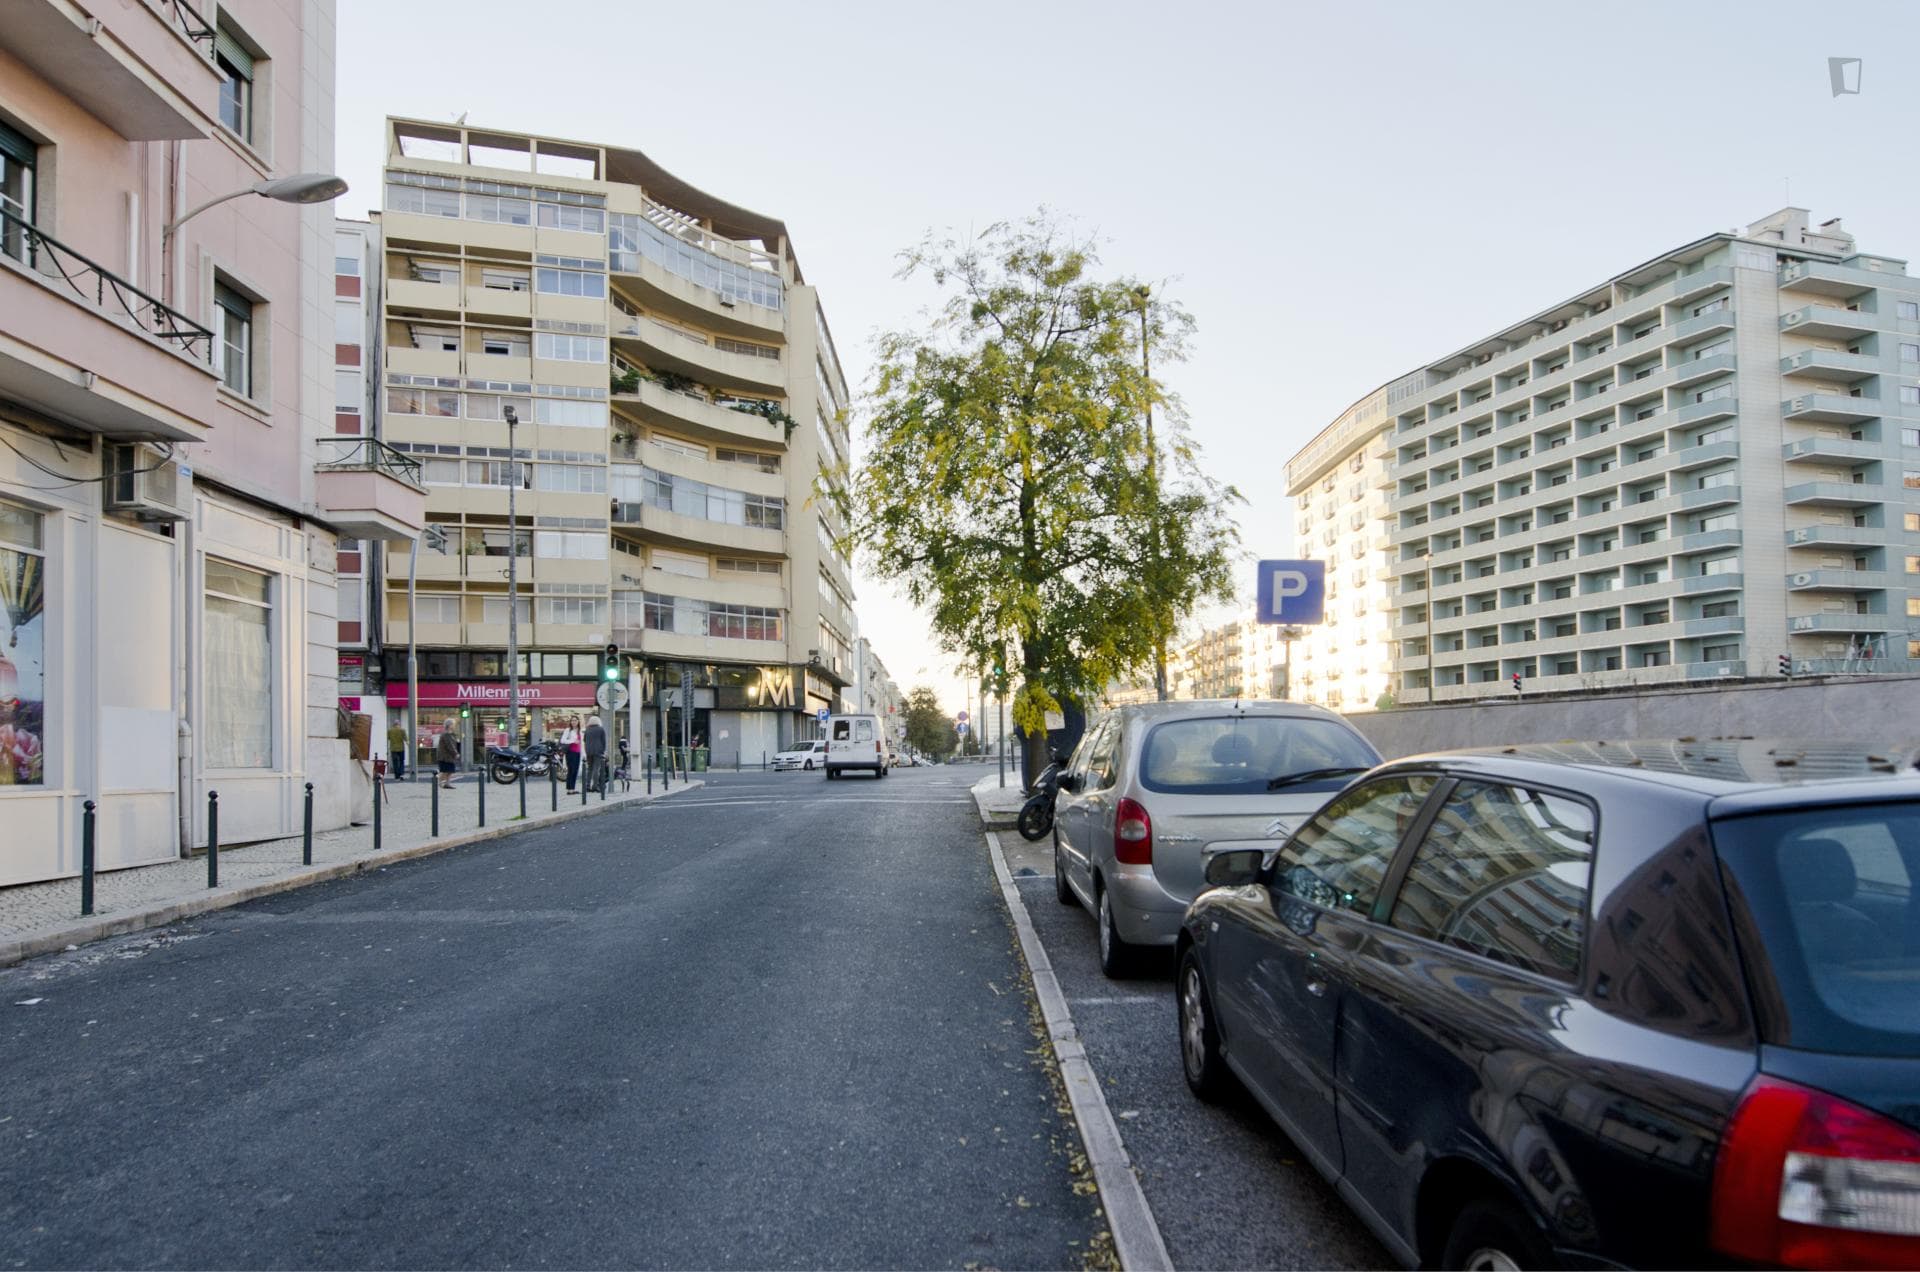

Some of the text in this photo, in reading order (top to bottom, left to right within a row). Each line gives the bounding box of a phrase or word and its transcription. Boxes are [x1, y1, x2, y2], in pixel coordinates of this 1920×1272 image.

[1272, 570, 1307, 615] P
[1793, 528, 1814, 673] ROMA
[457, 684, 540, 698] Millennum
[755, 666, 795, 707] M
